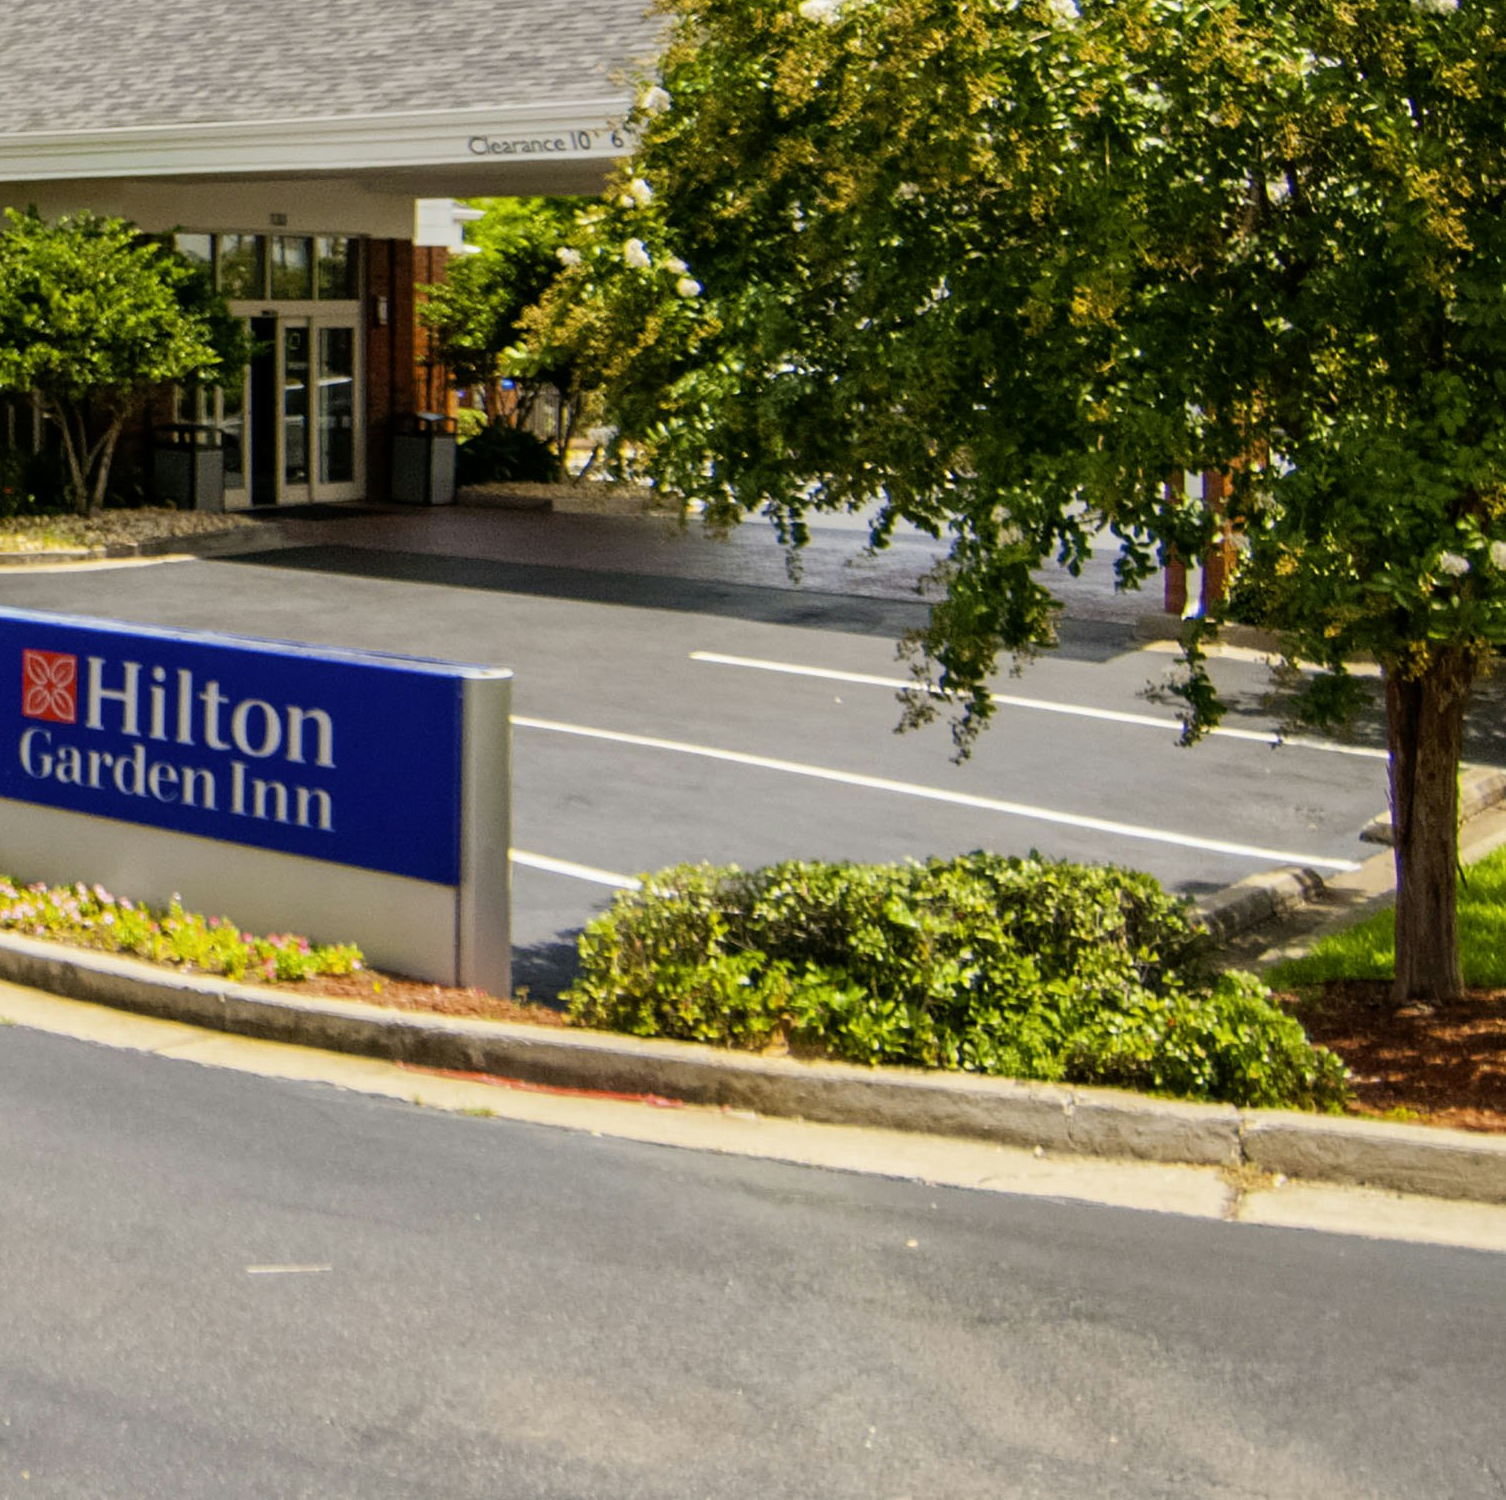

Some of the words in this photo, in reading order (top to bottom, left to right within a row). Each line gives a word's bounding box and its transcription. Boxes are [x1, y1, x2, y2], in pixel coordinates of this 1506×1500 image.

[468, 135, 566, 156] Clearance
[86, 657, 337, 768] Hilton
[20, 728, 217, 811] Garden
[231, 761, 335, 832] Inn
